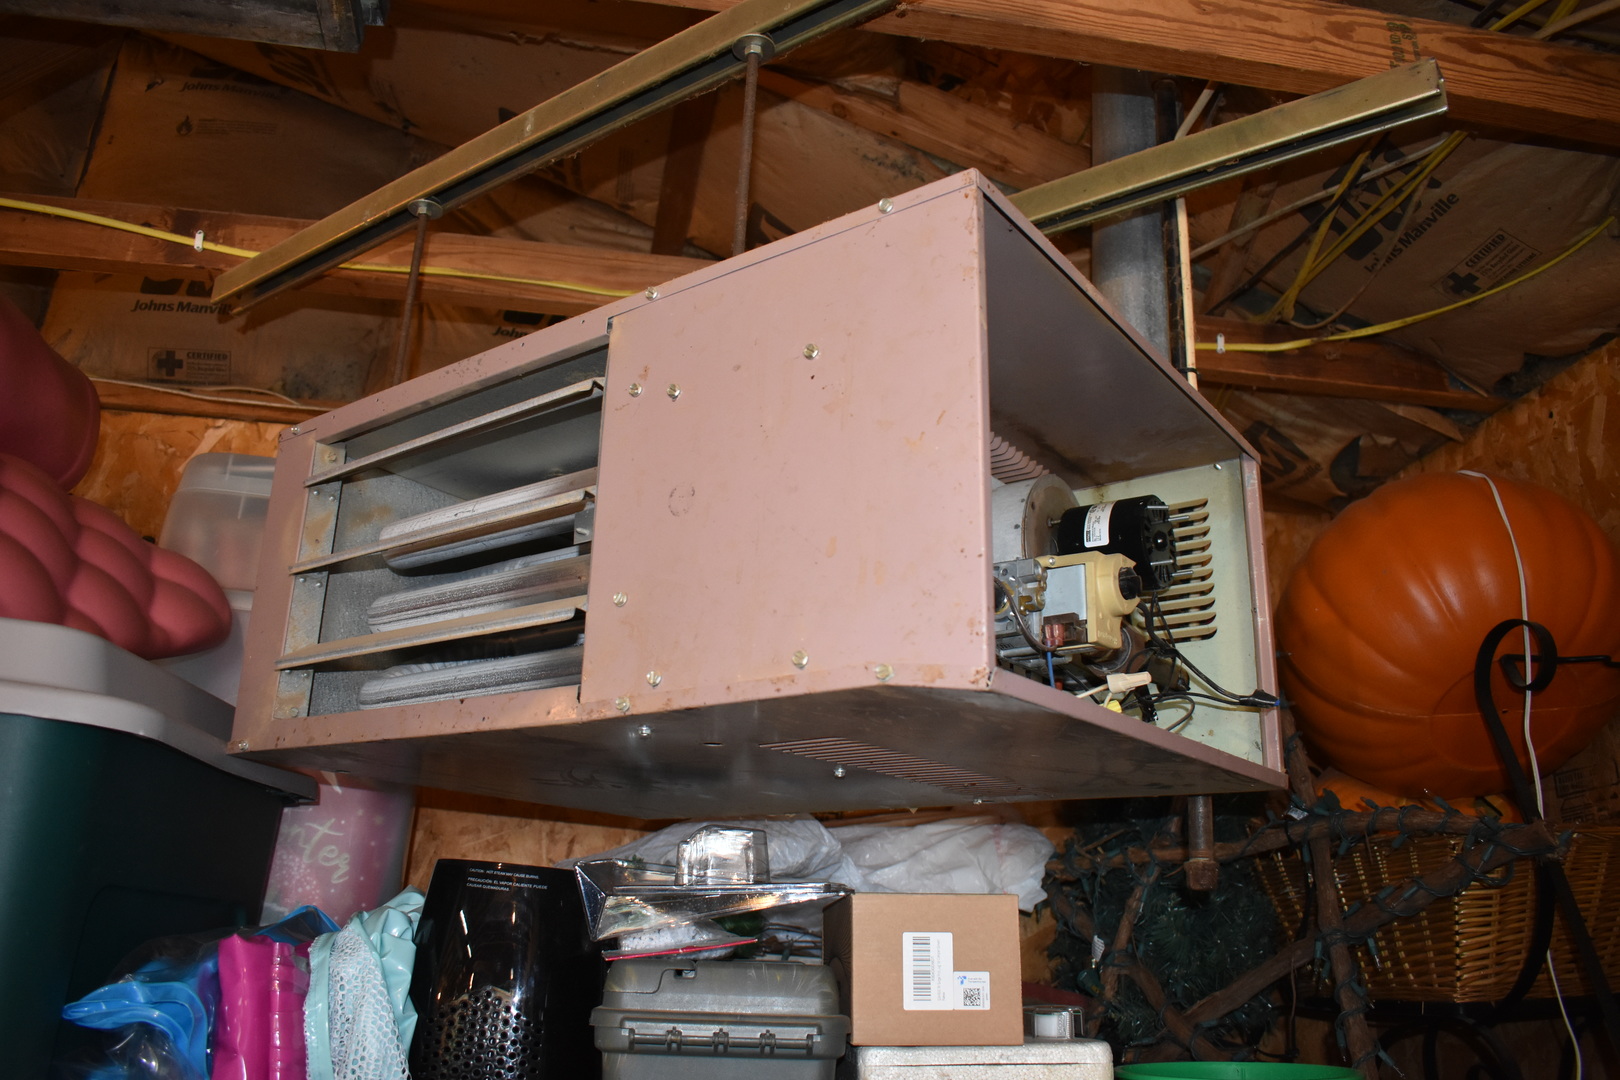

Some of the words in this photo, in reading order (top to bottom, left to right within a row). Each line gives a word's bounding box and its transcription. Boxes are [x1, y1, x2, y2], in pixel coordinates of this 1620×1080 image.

[179, 82, 219, 92] Johns
[1398, 193, 1460, 248] Manville
[1465, 233, 1505, 268] CERTIFIED
[131, 299, 174, 312] Johns
[176, 301, 233, 314] Manvill
[186, 351, 228, 360] CERTIFIED
